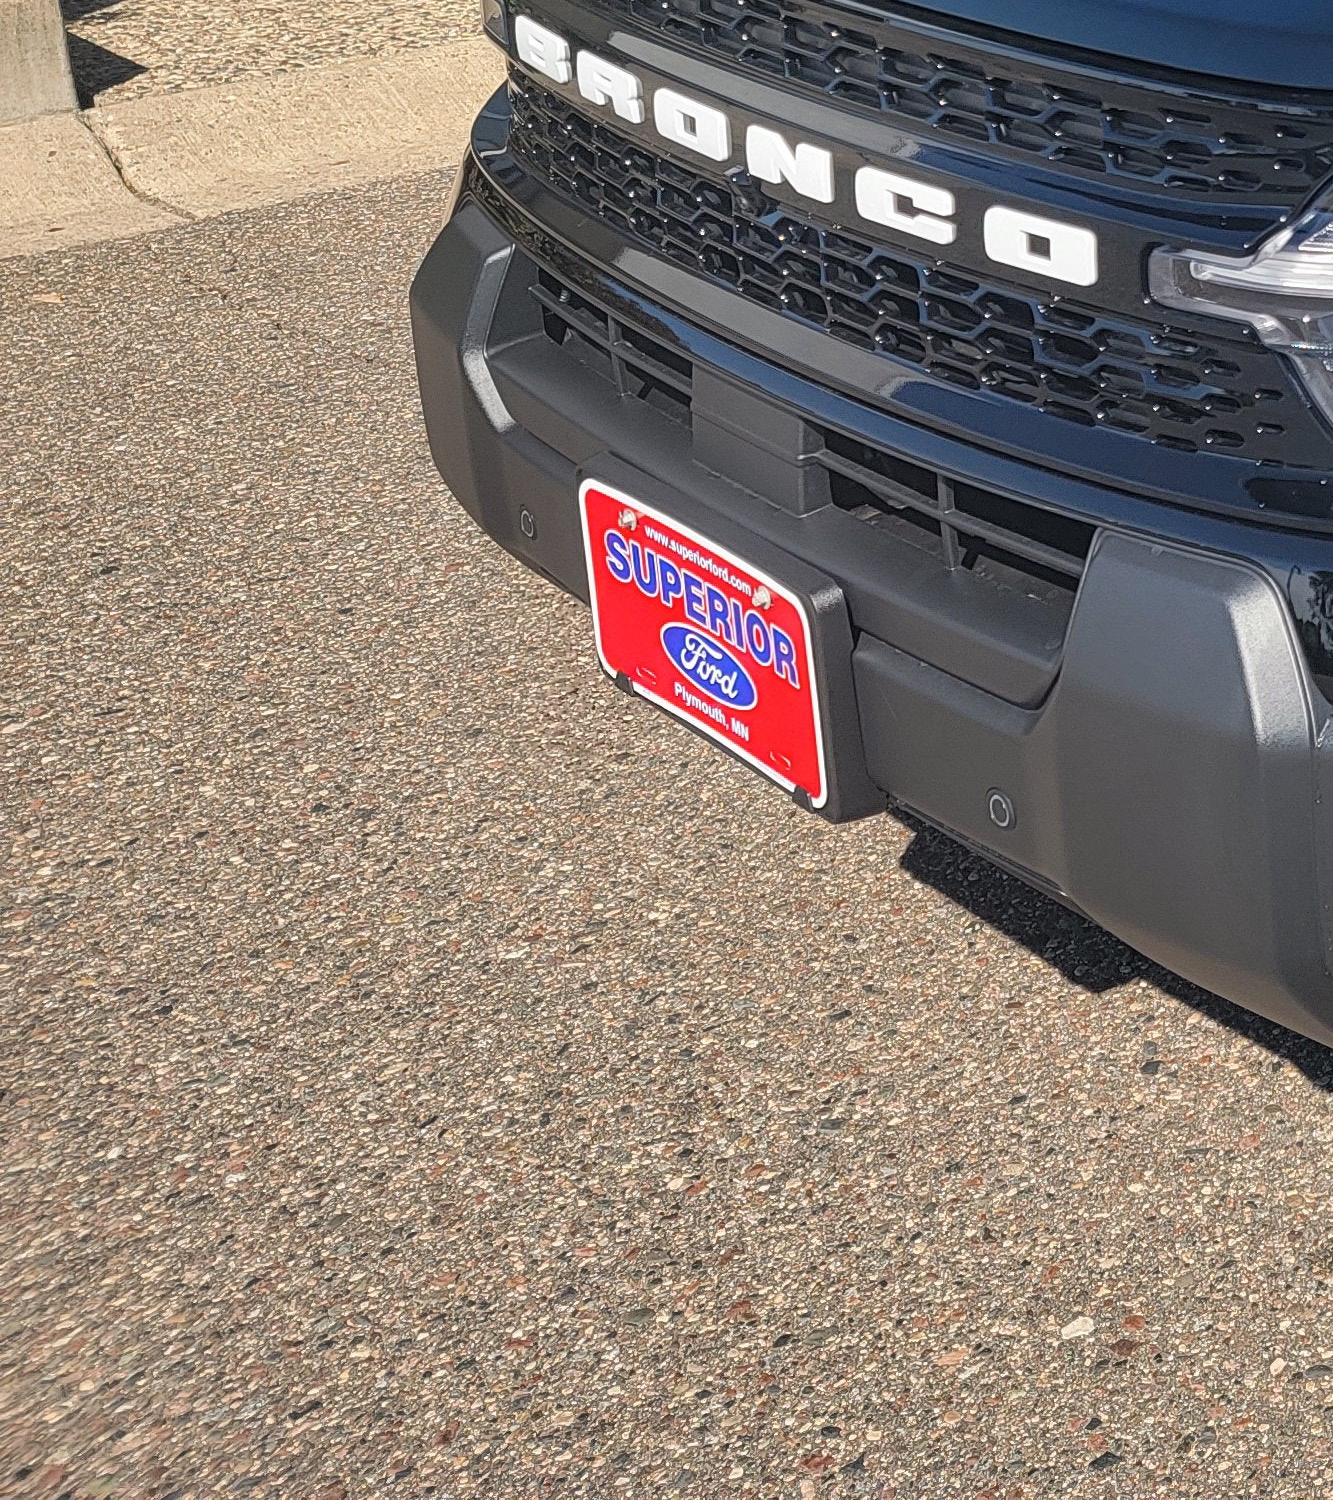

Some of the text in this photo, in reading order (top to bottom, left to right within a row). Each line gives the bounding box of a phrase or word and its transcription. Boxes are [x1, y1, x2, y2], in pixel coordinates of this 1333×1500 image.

[514, 14, 1099, 288] BRONCO
[644, 524, 752, 597] www.superiorford.com
[604, 528, 801, 690] SUPERIOR
[680, 633, 740, 699] Ford
[674, 681, 750, 742] Plymouth, MN
